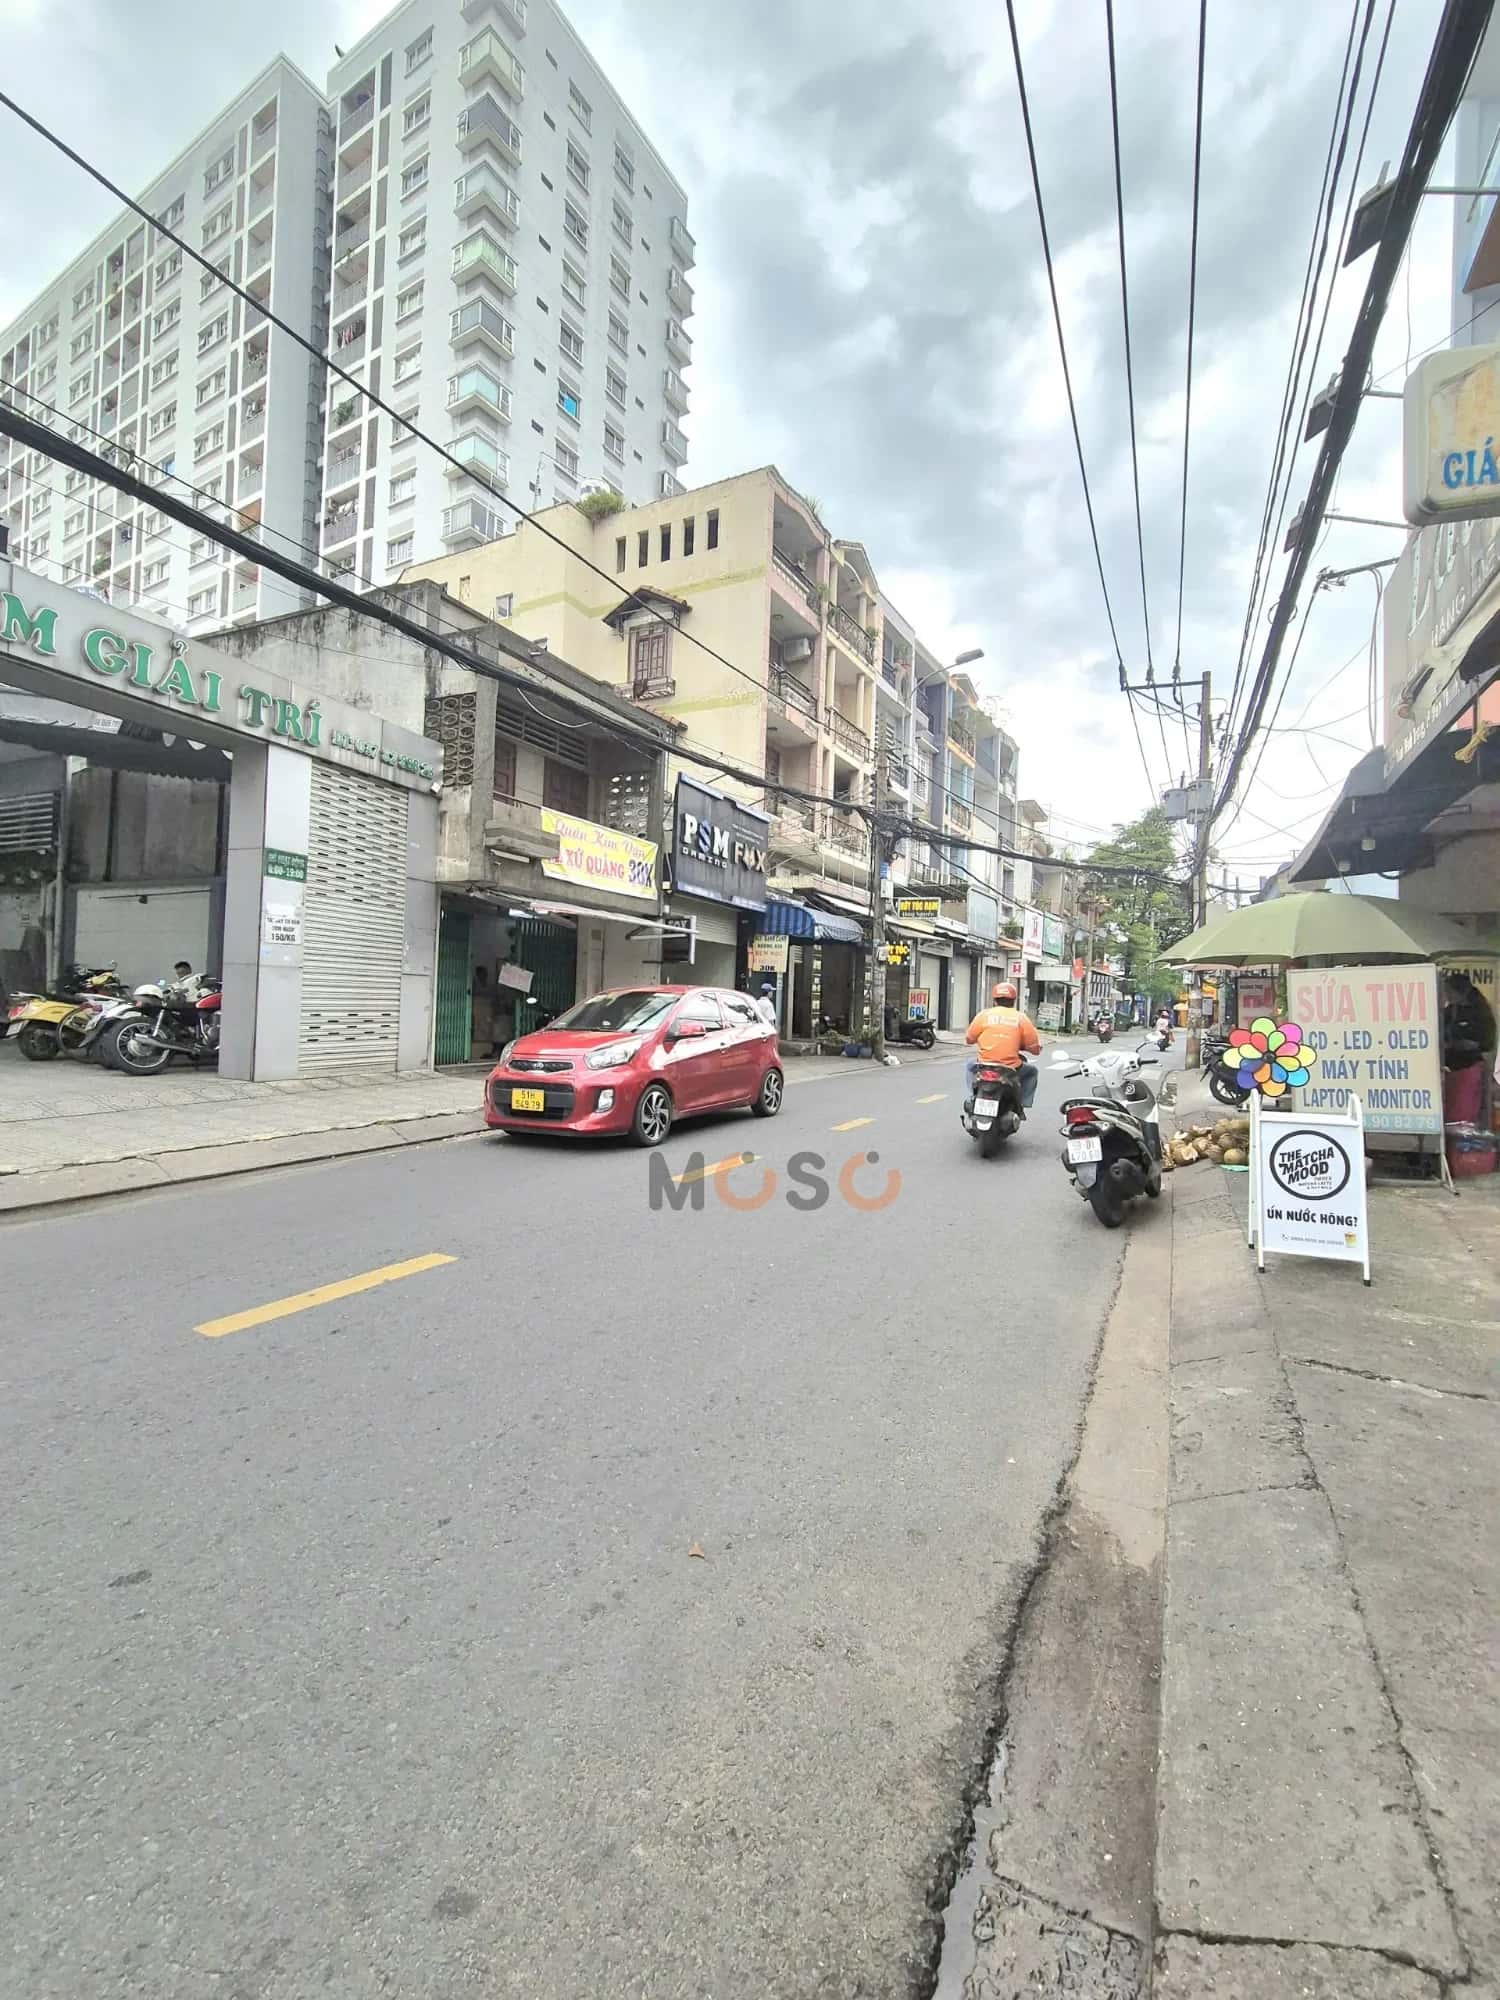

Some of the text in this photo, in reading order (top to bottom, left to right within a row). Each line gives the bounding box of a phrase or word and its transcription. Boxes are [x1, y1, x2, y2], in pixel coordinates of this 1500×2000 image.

[1443, 437, 1500, 489] GIÁ
[85, 629, 222, 713] GIẢI
[240, 684, 323, 747] TRÍ
[586, 850, 625, 881] QUẢNG
[1297, 974, 1428, 1024] SỬA TIVI
[1308, 1029, 1429, 1051] CD LED OLED
[1322, 1055, 1409, 1080] MÁY TÍNH
[1368, 1088, 1432, 1109] MONITOR
[1279, 1147, 1335, 1175] MATCHA
[1280, 1149, 1302, 1163] THE
[1287, 1161, 1329, 1184] MOOD
[1267, 1205, 1283, 1220] ÚN
[1286, 1208, 1317, 1223] NƯỚC
